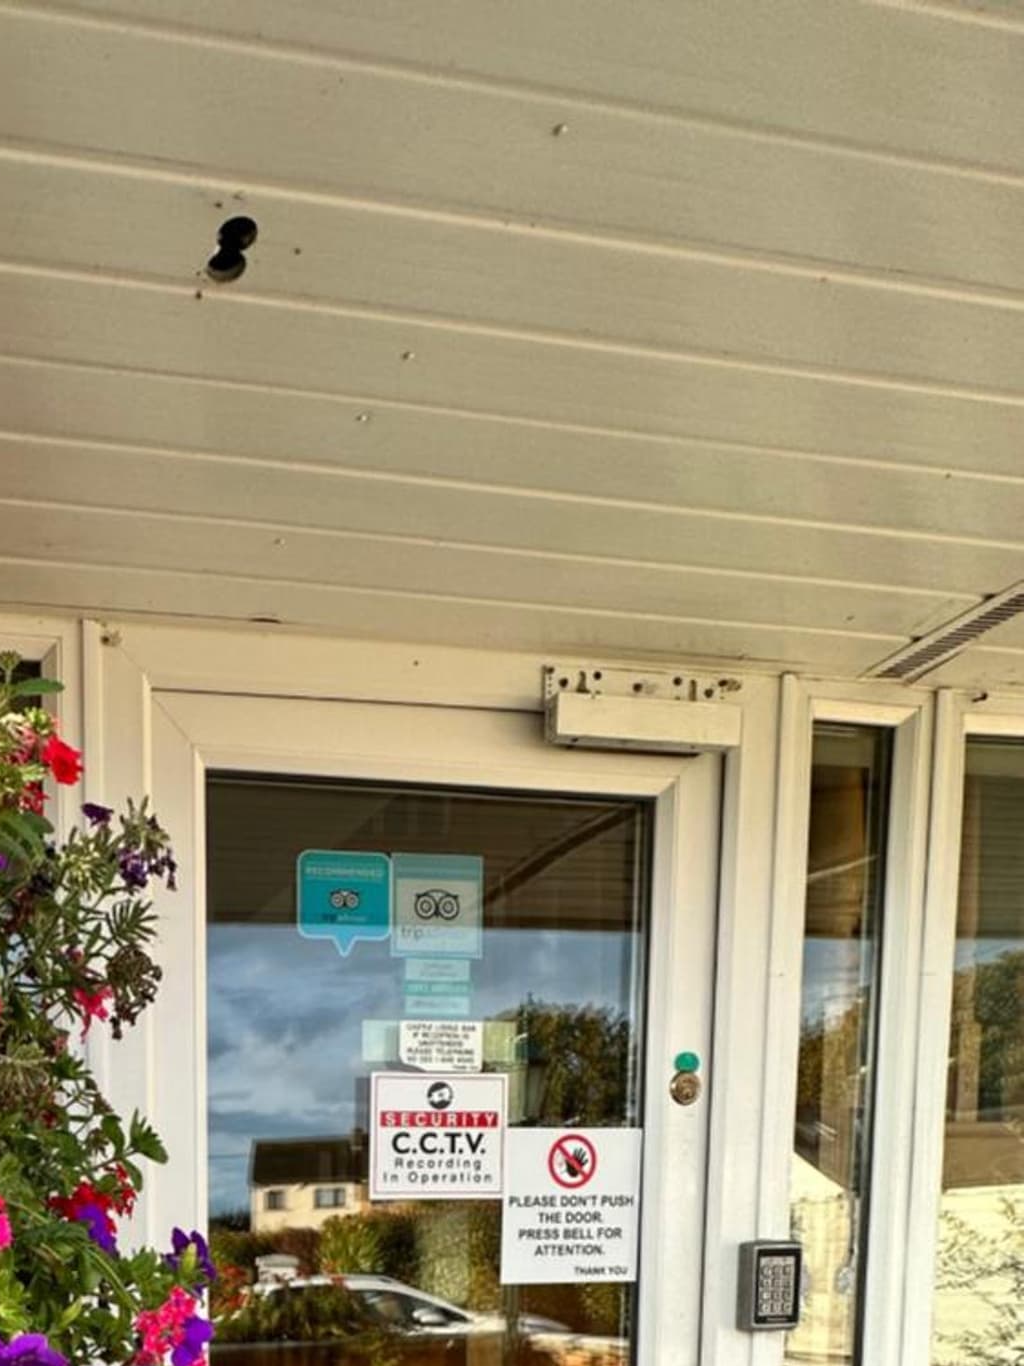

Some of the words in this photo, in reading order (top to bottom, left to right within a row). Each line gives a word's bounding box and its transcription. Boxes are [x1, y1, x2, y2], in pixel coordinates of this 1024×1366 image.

[385, 1111, 495, 1128] SECURITY
[391, 1131, 486, 1154] C.C.T.V.
[394, 1158, 482, 1171] Recording
[383, 1172, 399, 1183] In
[407, 1171, 492, 1184] Operation
[508, 1195, 557, 1208] PLEASE
[559, 1195, 597, 1207] DON'T
[600, 1195, 634, 1207] PUSH
[538, 1211, 562, 1224] THE
[518, 1228, 560, 1240] PRESS
[562, 1228, 594, 1240] BELL
[597, 1227, 623, 1239] FOR
[534, 1244, 606, 1257] ATTENTION.
[574, 1266, 606, 1275] THANK
[608, 1266, 628, 1275] YOU
